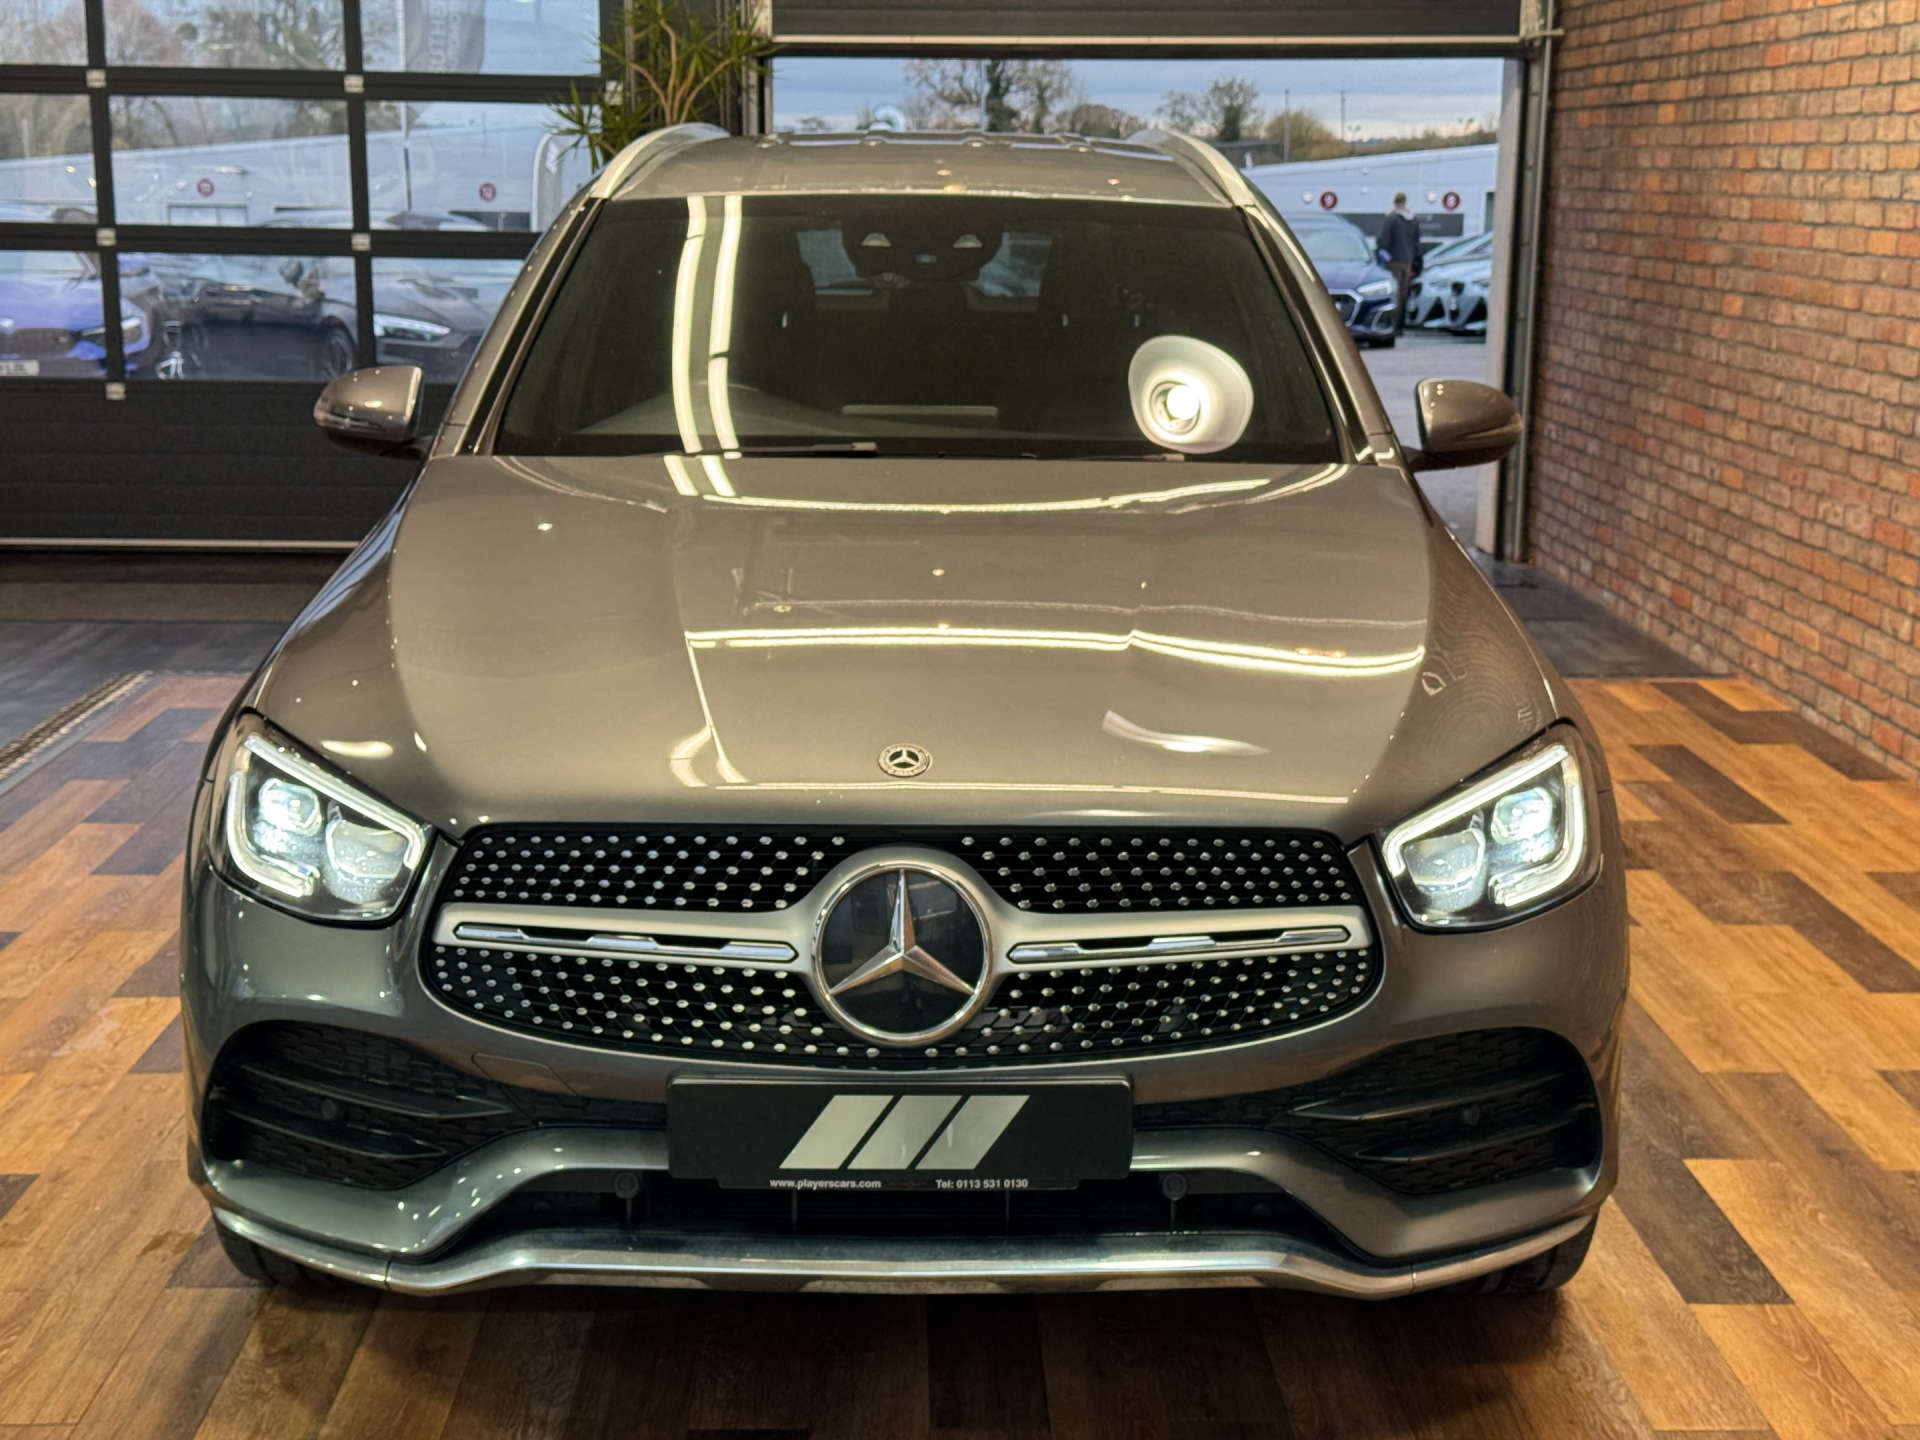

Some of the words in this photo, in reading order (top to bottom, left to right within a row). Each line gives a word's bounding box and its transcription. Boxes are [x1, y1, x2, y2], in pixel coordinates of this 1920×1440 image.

[769, 1179, 882, 1190] www.playerscars.com
[935, 1179, 954, 1189] Tel:
[956, 1179, 980, 1189] 0113
[983, 1179, 1001, 1189] 531
[1003, 1179, 1029, 1189] 0130
